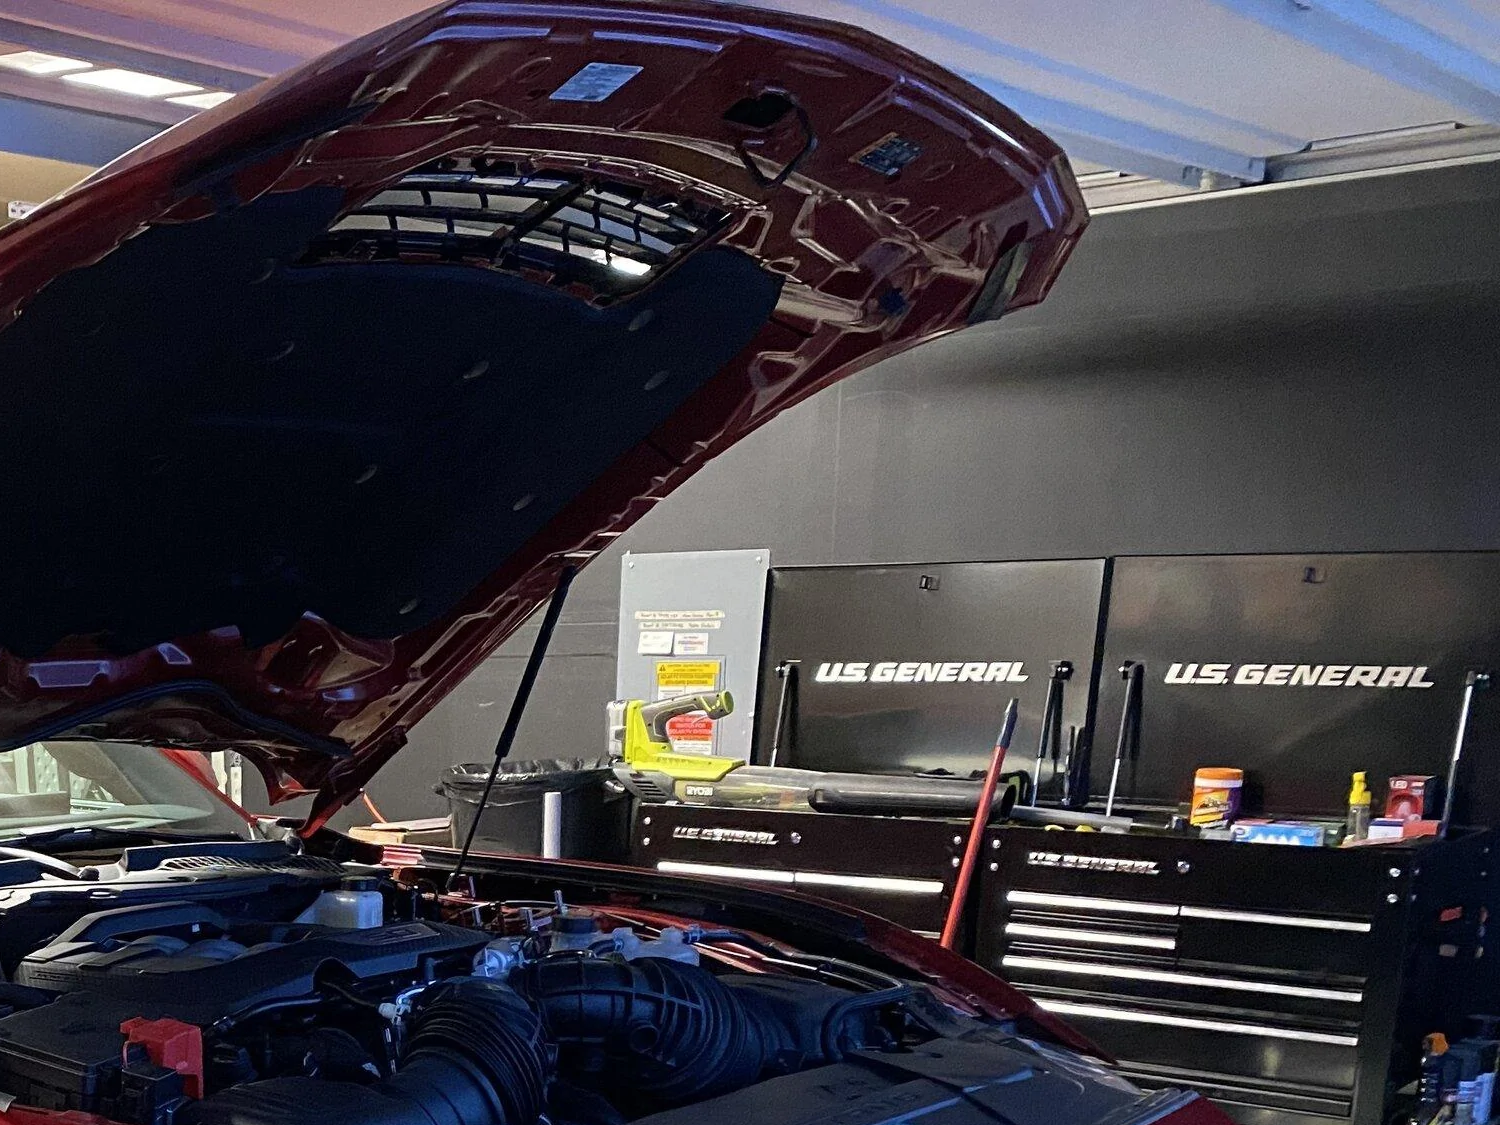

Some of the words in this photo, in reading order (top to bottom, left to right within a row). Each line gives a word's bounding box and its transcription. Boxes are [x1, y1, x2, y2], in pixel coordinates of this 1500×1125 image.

[814, 662, 870, 682] U.S.
[868, 662, 1029, 683] GENERAL
[1163, 663, 1231, 685] U.S.
[1233, 664, 1435, 689] GENERAL
[686, 786, 713, 796] RYOBI
